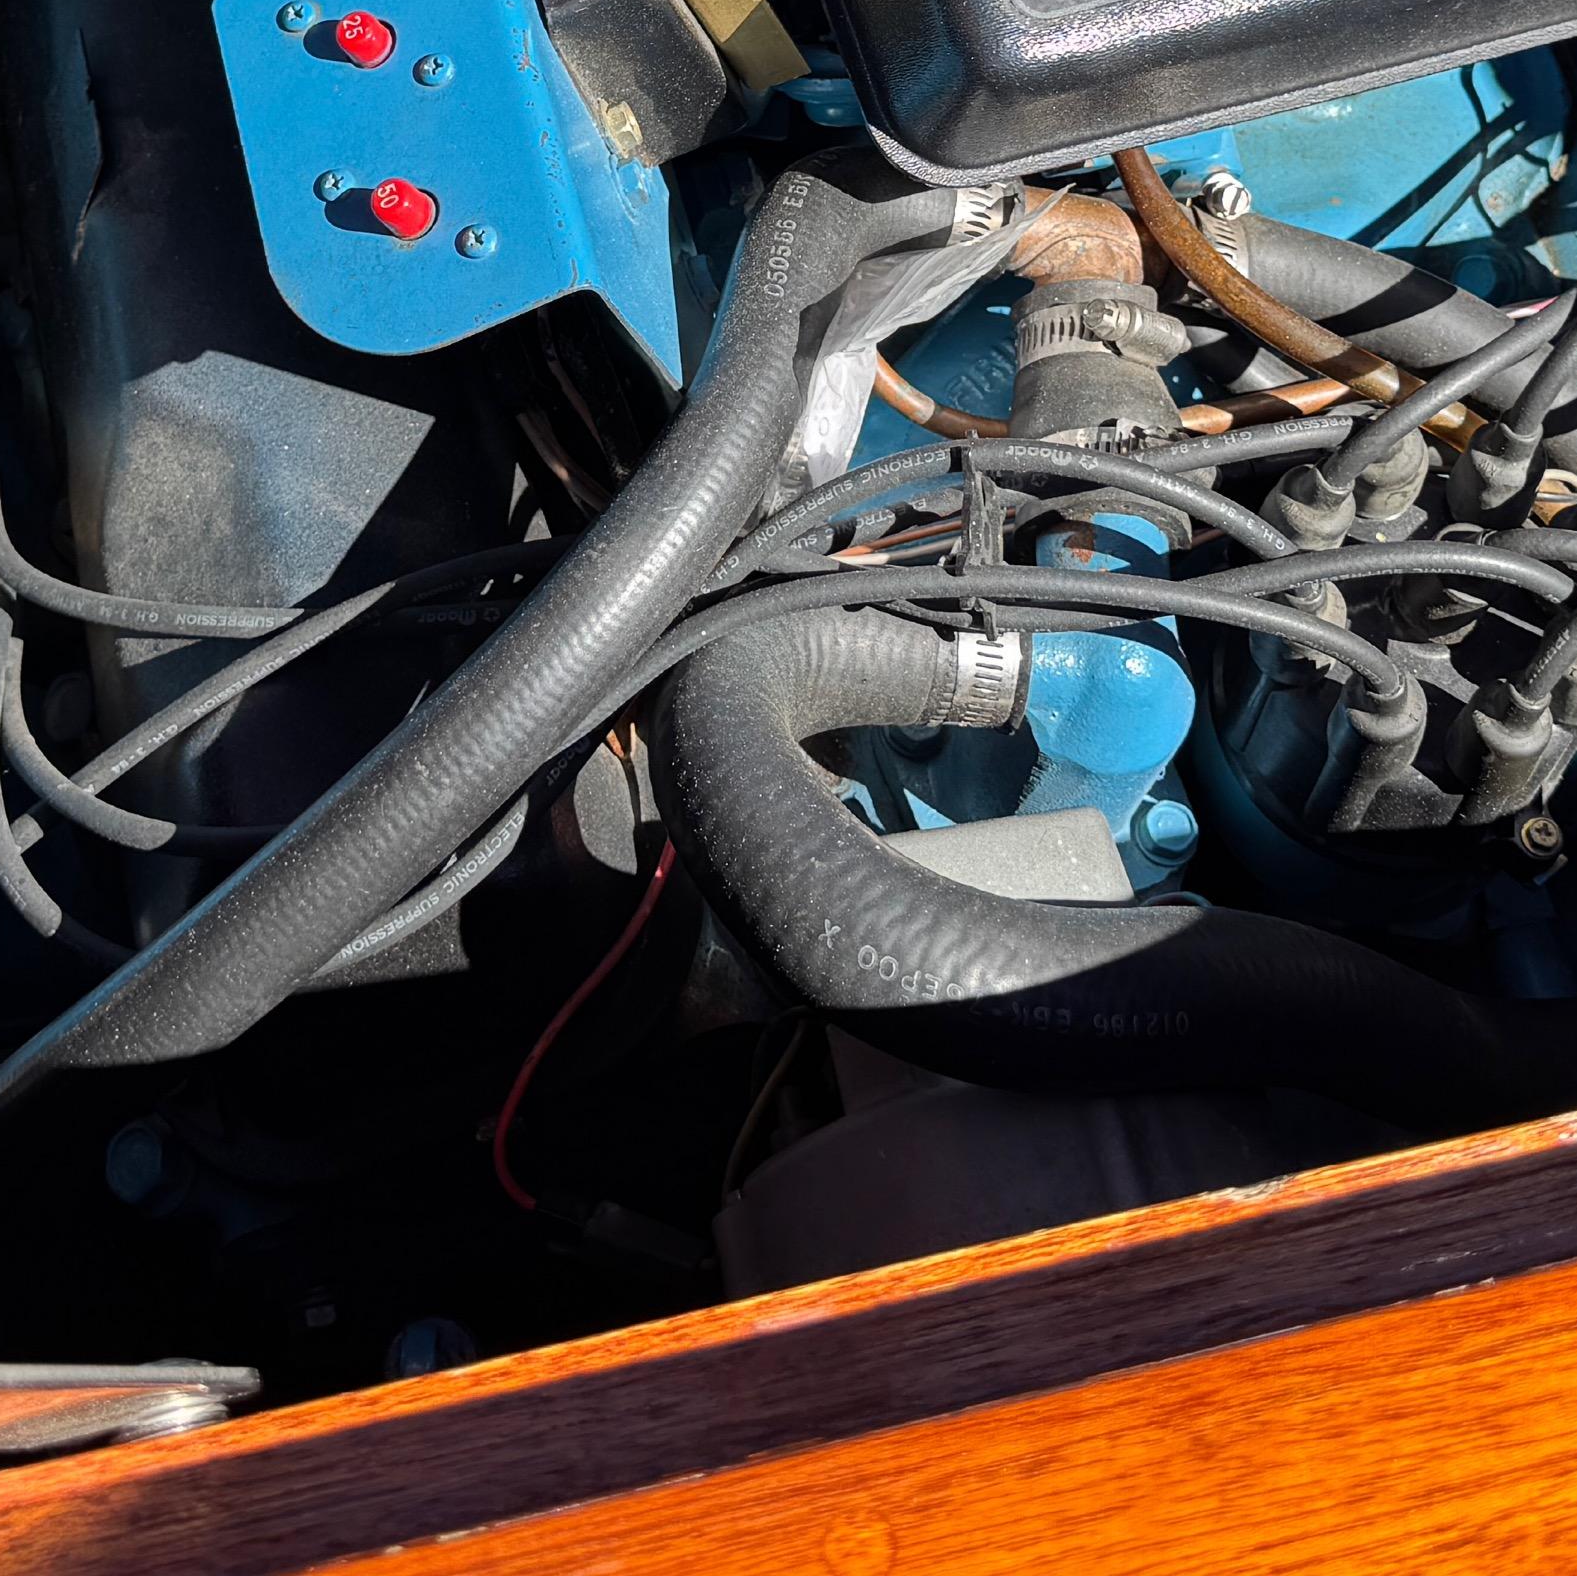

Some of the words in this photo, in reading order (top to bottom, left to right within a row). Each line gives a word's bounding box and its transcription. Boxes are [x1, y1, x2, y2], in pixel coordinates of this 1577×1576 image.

[341, 15, 364, 40] 25
[377, 183, 400, 210] 50
[753, 475, 856, 550] SUPPRESSION
[176, 612, 274, 627] SUPPRESSION
[192, 655, 288, 717] SUPPRESSION
[445, 810, 525, 895] ELECTRONIC
[339, 892, 441, 959] SUPPRESSION
